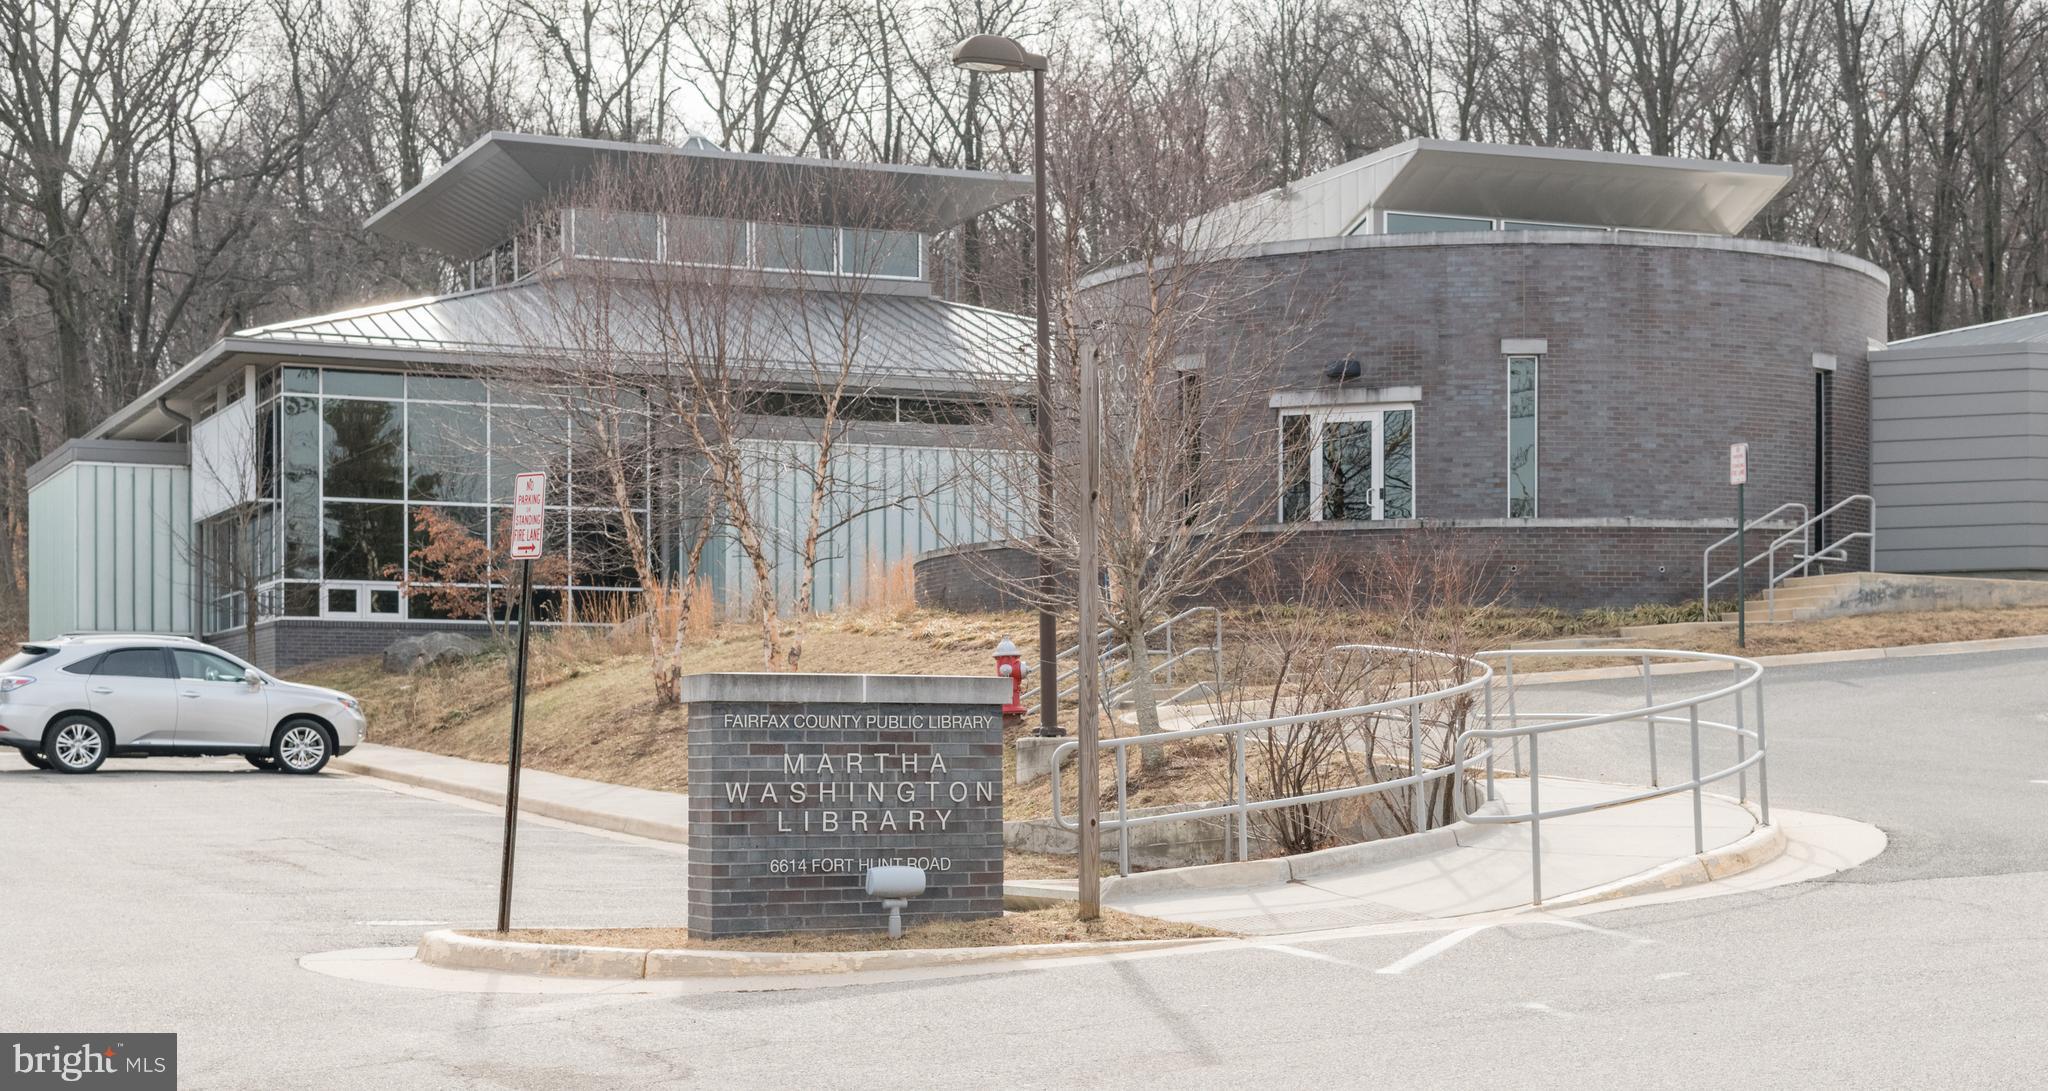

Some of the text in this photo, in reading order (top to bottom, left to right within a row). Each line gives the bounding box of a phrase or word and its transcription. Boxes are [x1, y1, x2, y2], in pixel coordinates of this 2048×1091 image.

[518, 494, 541, 505] PARKING
[515, 515, 541, 526] STANDING
[513, 527, 541, 542] FIRE LANE
[724, 714, 993, 729] FAIRFAX COUNTY PUBLIC LIBRARY
[783, 753, 948, 774] MARTHA
[725, 781, 993, 803] WASHINGTON
[778, 810, 952, 832] LIBRARY
[770, 858, 807, 873] 6614
[812, 857, 854, 872] FORT
[907, 856, 951, 871] ROAD
